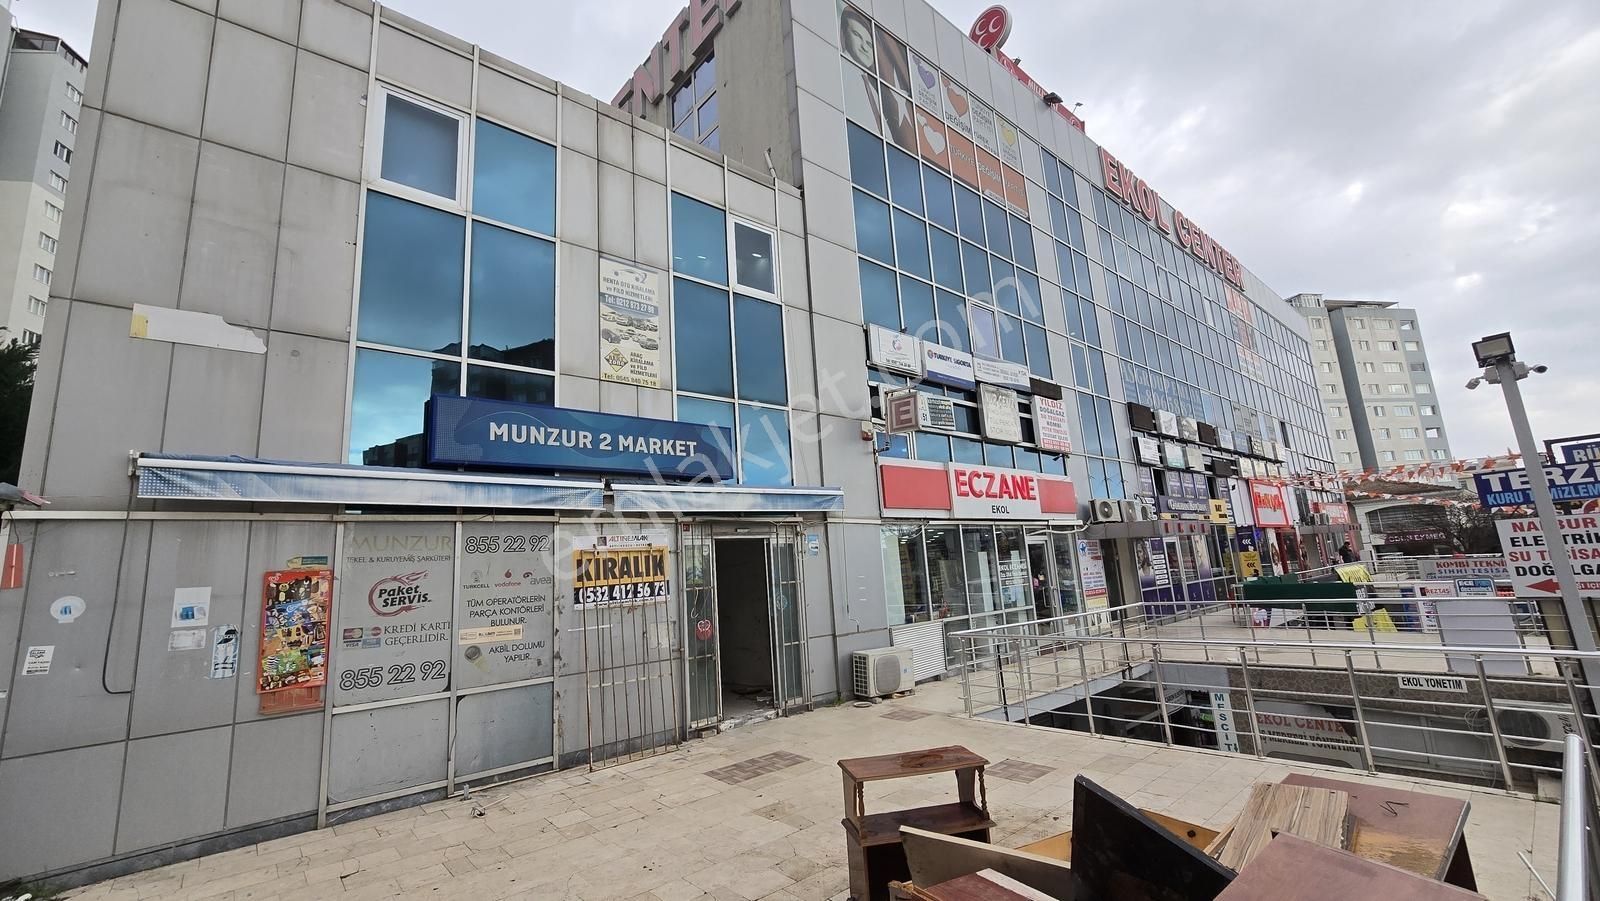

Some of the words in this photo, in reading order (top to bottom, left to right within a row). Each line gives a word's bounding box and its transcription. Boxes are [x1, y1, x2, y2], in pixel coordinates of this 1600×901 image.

[1099, 146, 1170, 235] EKOL
[1174, 209, 1245, 292] CENTER
[605, 294, 615, 304] Tel:
[489, 421, 593, 449] MUNZUR
[600, 433, 611, 450] 2
[618, 435, 697, 456] MARKET
[954, 469, 1037, 500] ECZANE
[1486, 491, 1523, 506] KURU
[1527, 483, 1600, 502] TMİZLEM
[991, 505, 1010, 514] EKOL
[1511, 517, 1598, 532] NABUR
[352, 535, 452, 552] MUNZUR
[465, 535, 500, 554] 855
[503, 535, 526, 553] 22
[529, 534, 551, 552] 92
[1509, 530, 1600, 547] ELETRİK
[347, 556, 366, 564] TEKEL
[1436, 560, 1470, 568] KOMBİ
[1471, 559, 1507, 568] TEKNİ
[1508, 551, 1531, 562] SU
[530, 576, 552, 585] avea
[377, 584, 420, 599] Paket
[579, 586, 608, 603] 0532
[612, 584, 634, 600] 412
[637, 582, 651, 598] 56
[654, 581, 666, 596] 73
[382, 592, 429, 608] SERVİS
[466, 599, 484, 608] TÜM
[485, 594, 546, 607] OPERATÖRLERİN
[469, 608, 498, 619] PARÇA
[499, 603, 545, 616] KONTÖRLERİ
[384, 622, 416, 635] KREDİ
[420, 621, 451, 632] KARTI
[488, 643, 510, 655] AKBİL
[511, 640, 546, 652] DOLUMU
[339, 666, 383, 691] 855
[387, 663, 416, 685] 22
[420, 659, 446, 681] 92
[1401, 676, 1424, 687] EKOL
[1256, 714, 1292, 727] EKOL
[1294, 716, 1345, 733] CENTE
